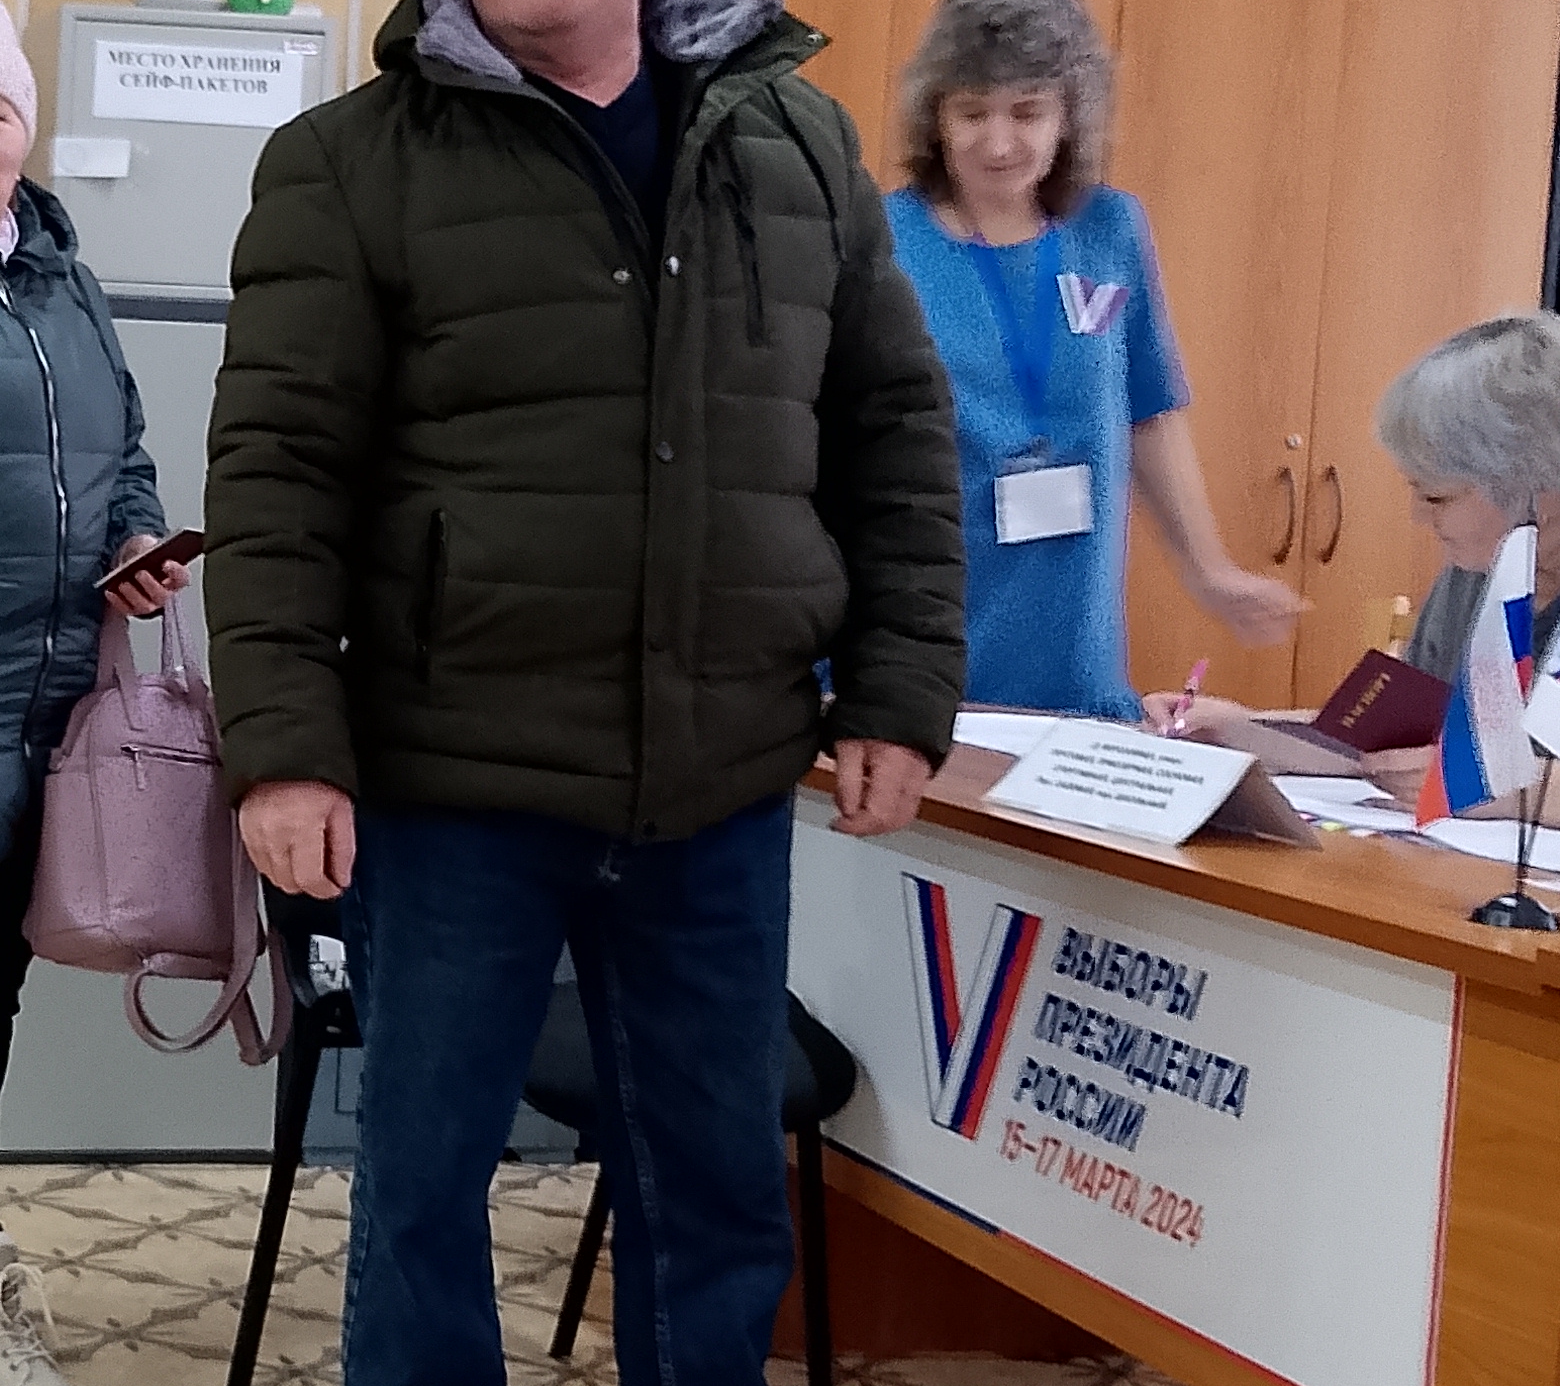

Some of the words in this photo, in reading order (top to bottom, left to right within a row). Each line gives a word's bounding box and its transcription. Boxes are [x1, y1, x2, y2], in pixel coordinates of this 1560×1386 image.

[108, 49, 177, 69] МЕСТО
[179, 53, 282, 74] ХРАНЕНИЯ
[118, 70, 269, 95] СЕЙФ-ПАКЕТОВ
[1051, 926, 1209, 1022] ВЫБОРЫ
[1033, 991, 1250, 1119] ПРЕЗИДЕНТА
[1012, 1055, 1147, 1152] РОССИИ
[1057, 1145, 1142, 1220] МАРТА
[1140, 1183, 1205, 1248] 2024
